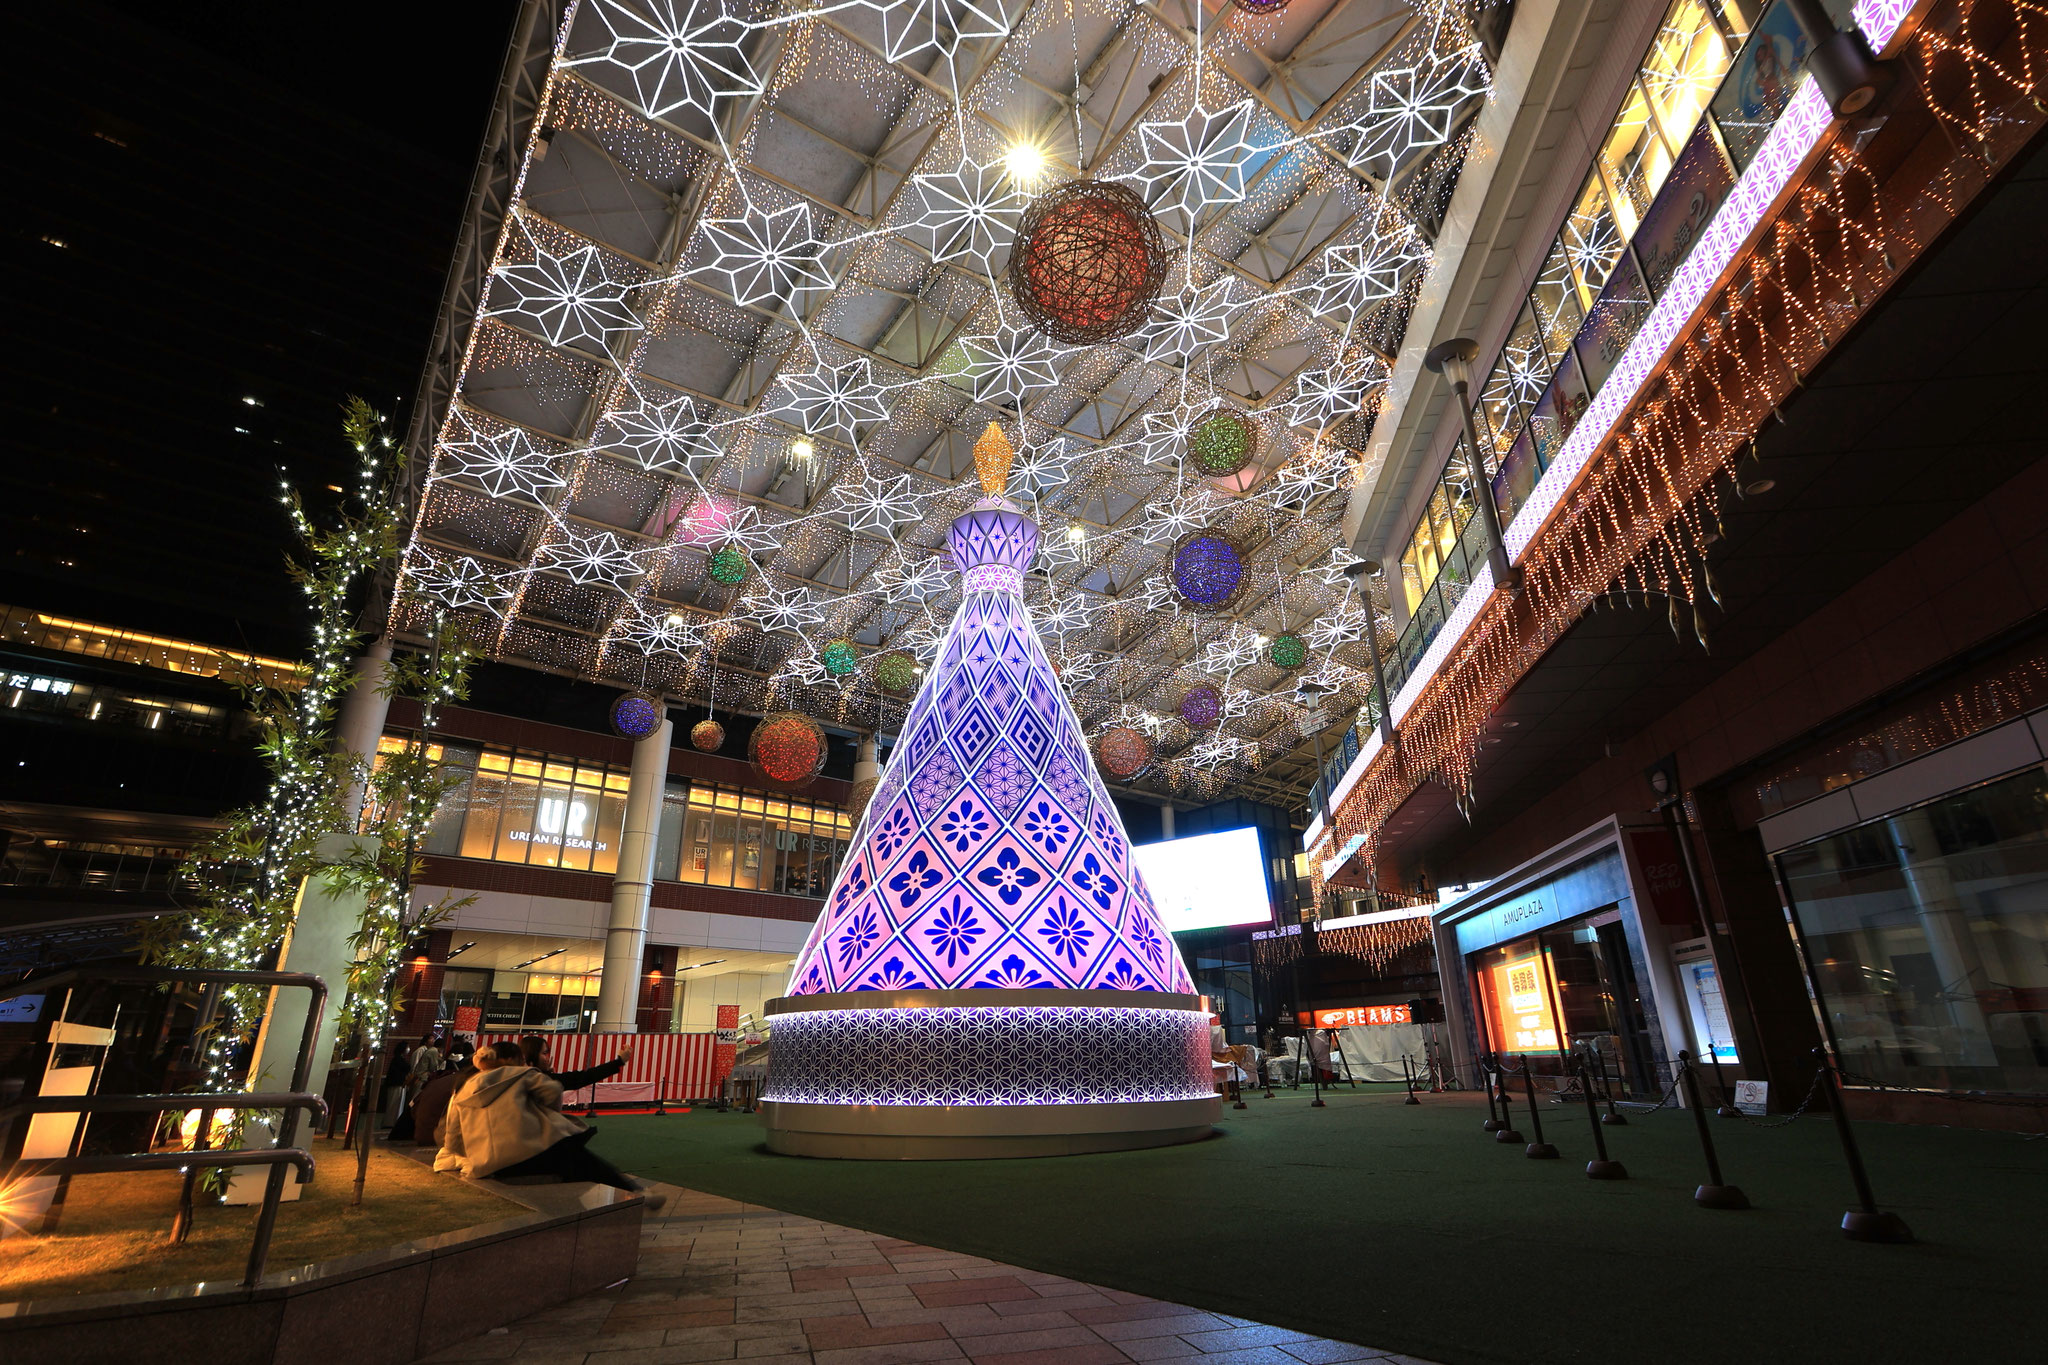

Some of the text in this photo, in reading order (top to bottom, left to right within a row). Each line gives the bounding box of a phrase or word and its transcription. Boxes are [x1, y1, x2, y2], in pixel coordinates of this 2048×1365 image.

[540, 798, 588, 837] UR
[552, 836, 607, 851] RSEARH
[1503, 898, 1545, 927] AMUPLAZA
[1346, 1006, 1406, 1025] BEAMS
